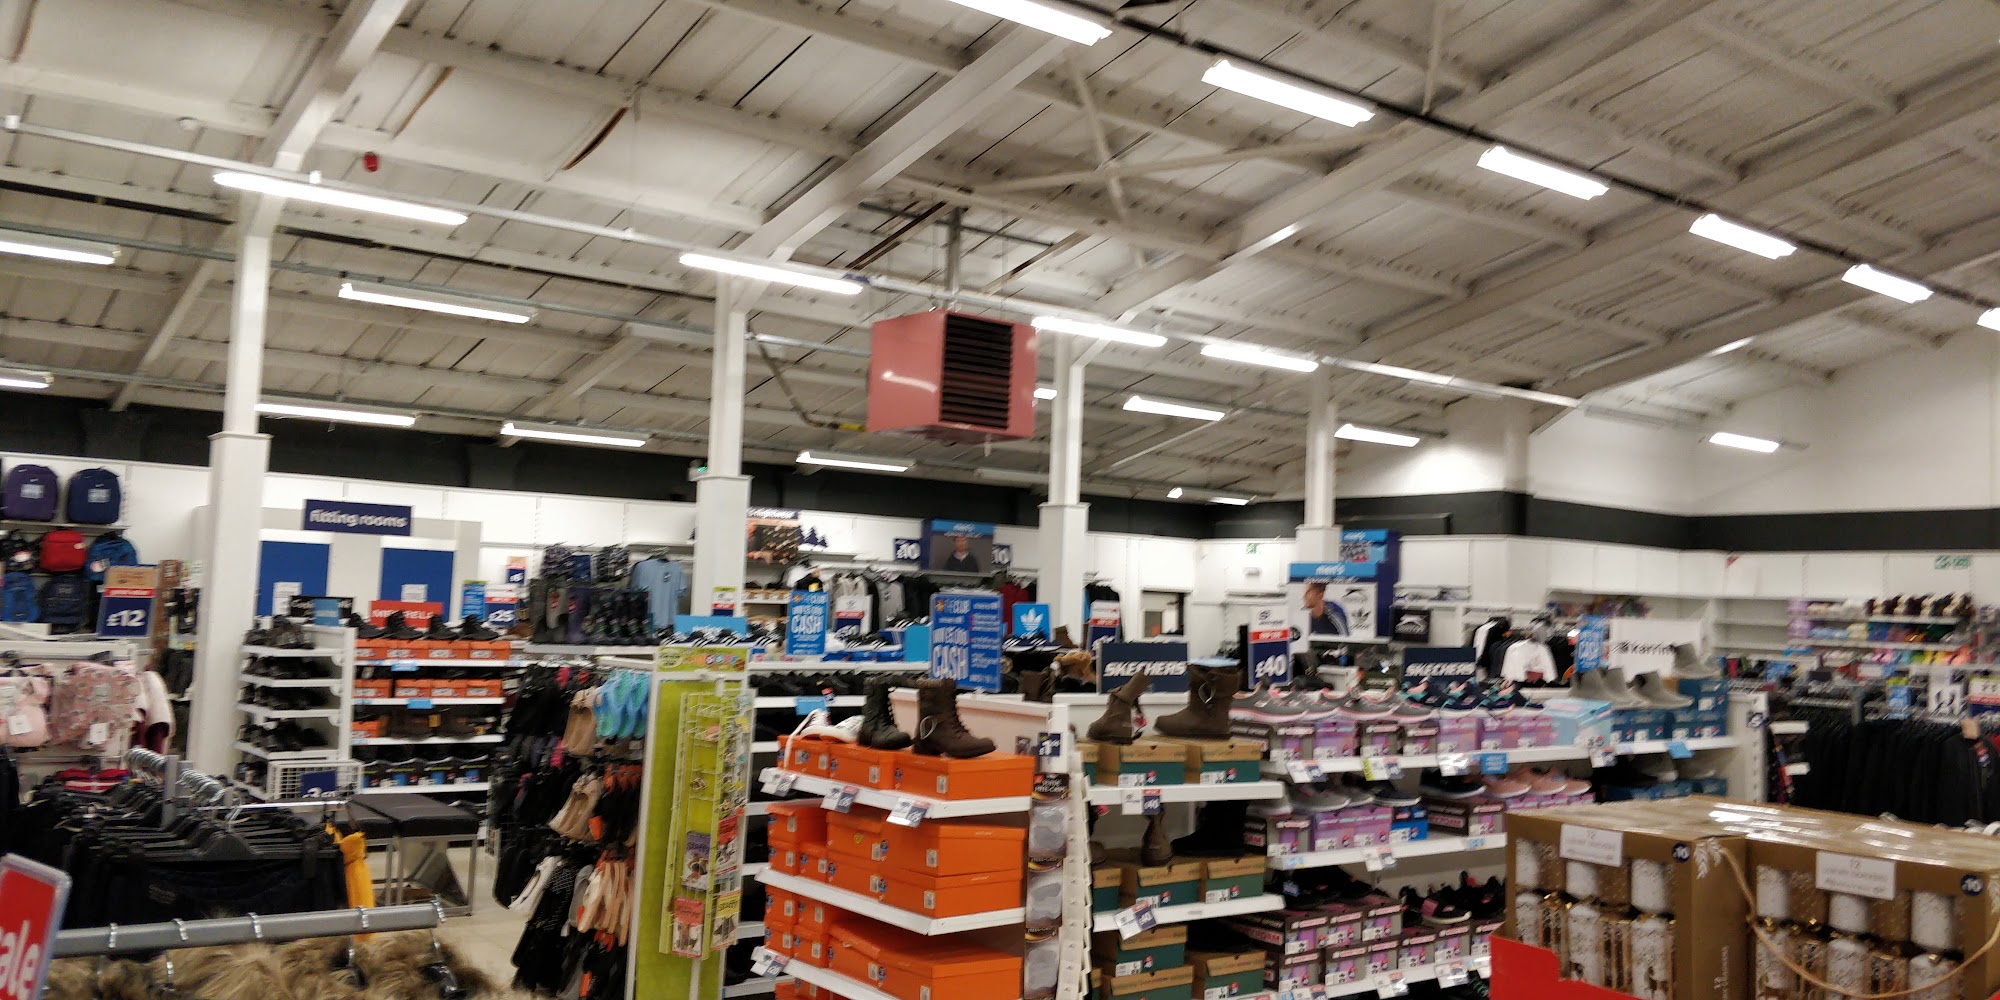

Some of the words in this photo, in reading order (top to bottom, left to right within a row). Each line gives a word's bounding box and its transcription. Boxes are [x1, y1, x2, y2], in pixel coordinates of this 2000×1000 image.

[310, 509, 358, 527] fitting
[359, 515, 408, 528] rooms
[106, 609, 146, 627] £12
[372, 609, 434, 620] MERELL
[488, 609, 516, 622] £25
[791, 615, 824, 635] CASH
[932, 645, 969, 680] CASH
[1255, 654, 1287, 679] £40
[1404, 662, 1477, 677] SKECHERS
[0, 919, 40, 1000] ale
